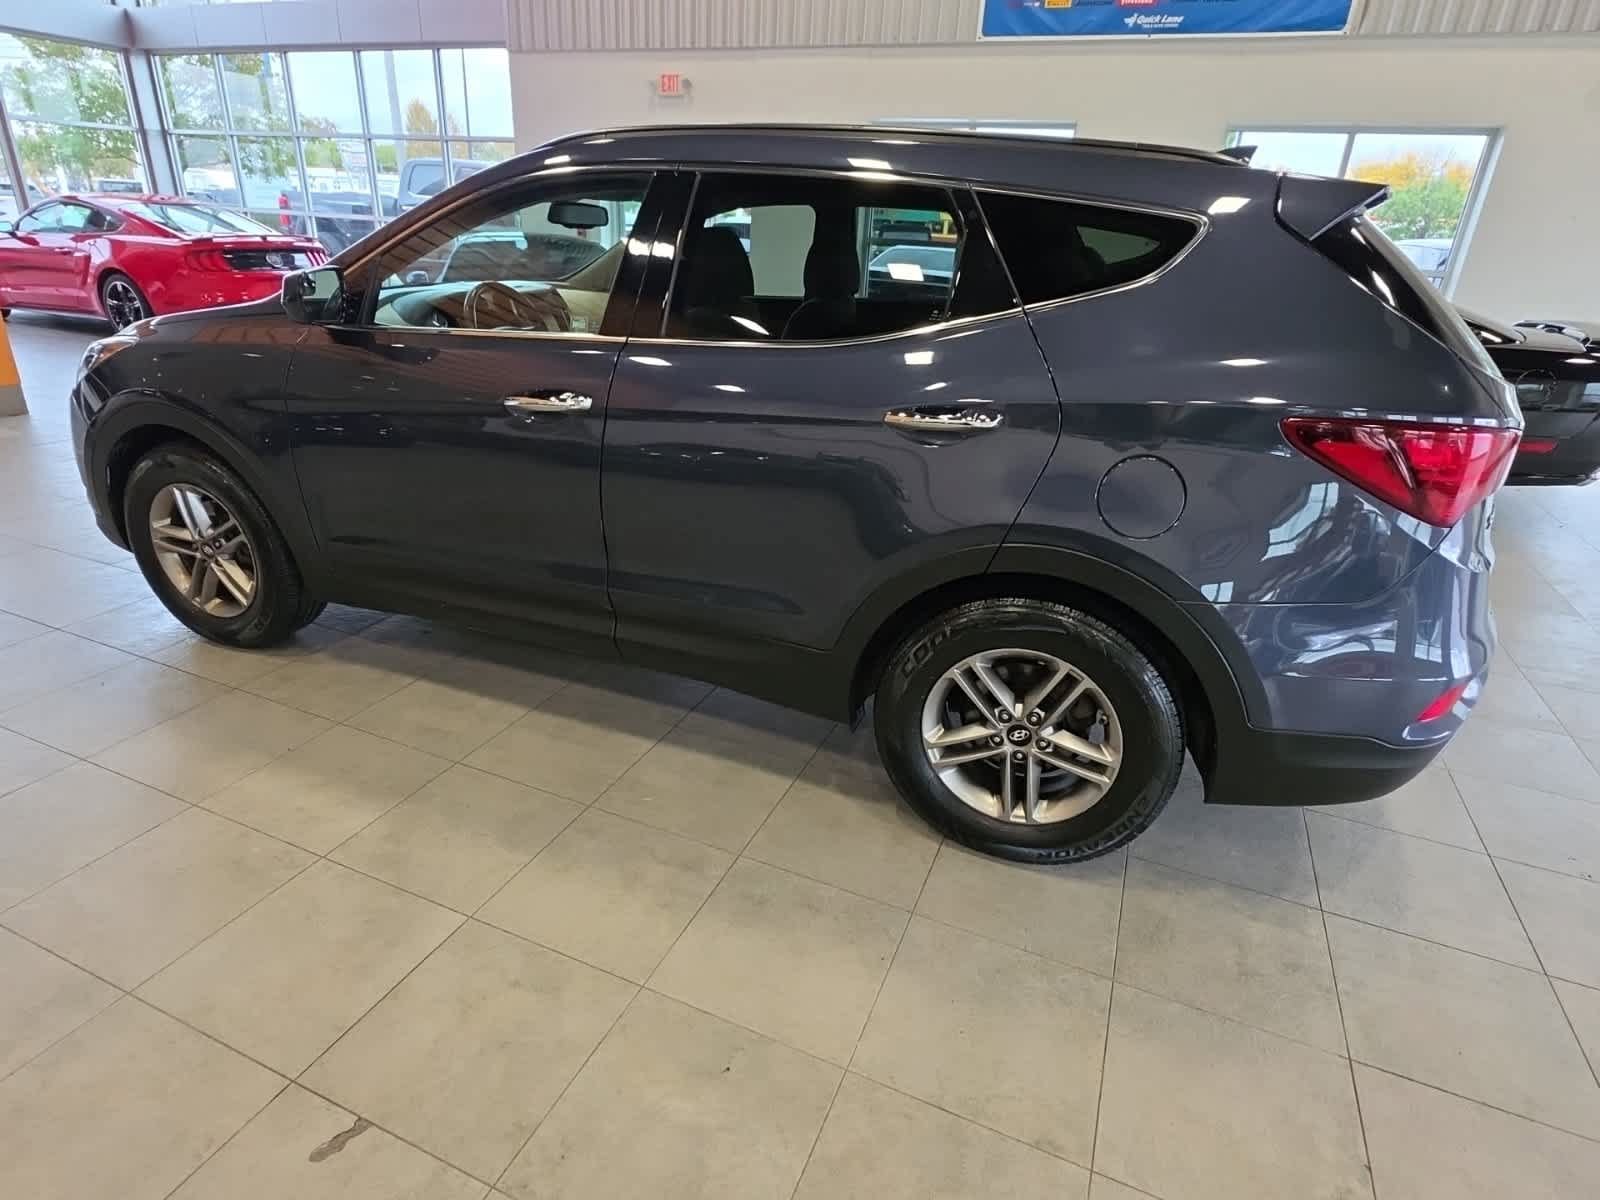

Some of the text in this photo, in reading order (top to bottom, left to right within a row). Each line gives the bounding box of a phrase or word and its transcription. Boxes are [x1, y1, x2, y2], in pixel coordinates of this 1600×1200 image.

[1136, 14, 1185, 25] Quick Lane
[661, 74, 679, 92] EXIT
